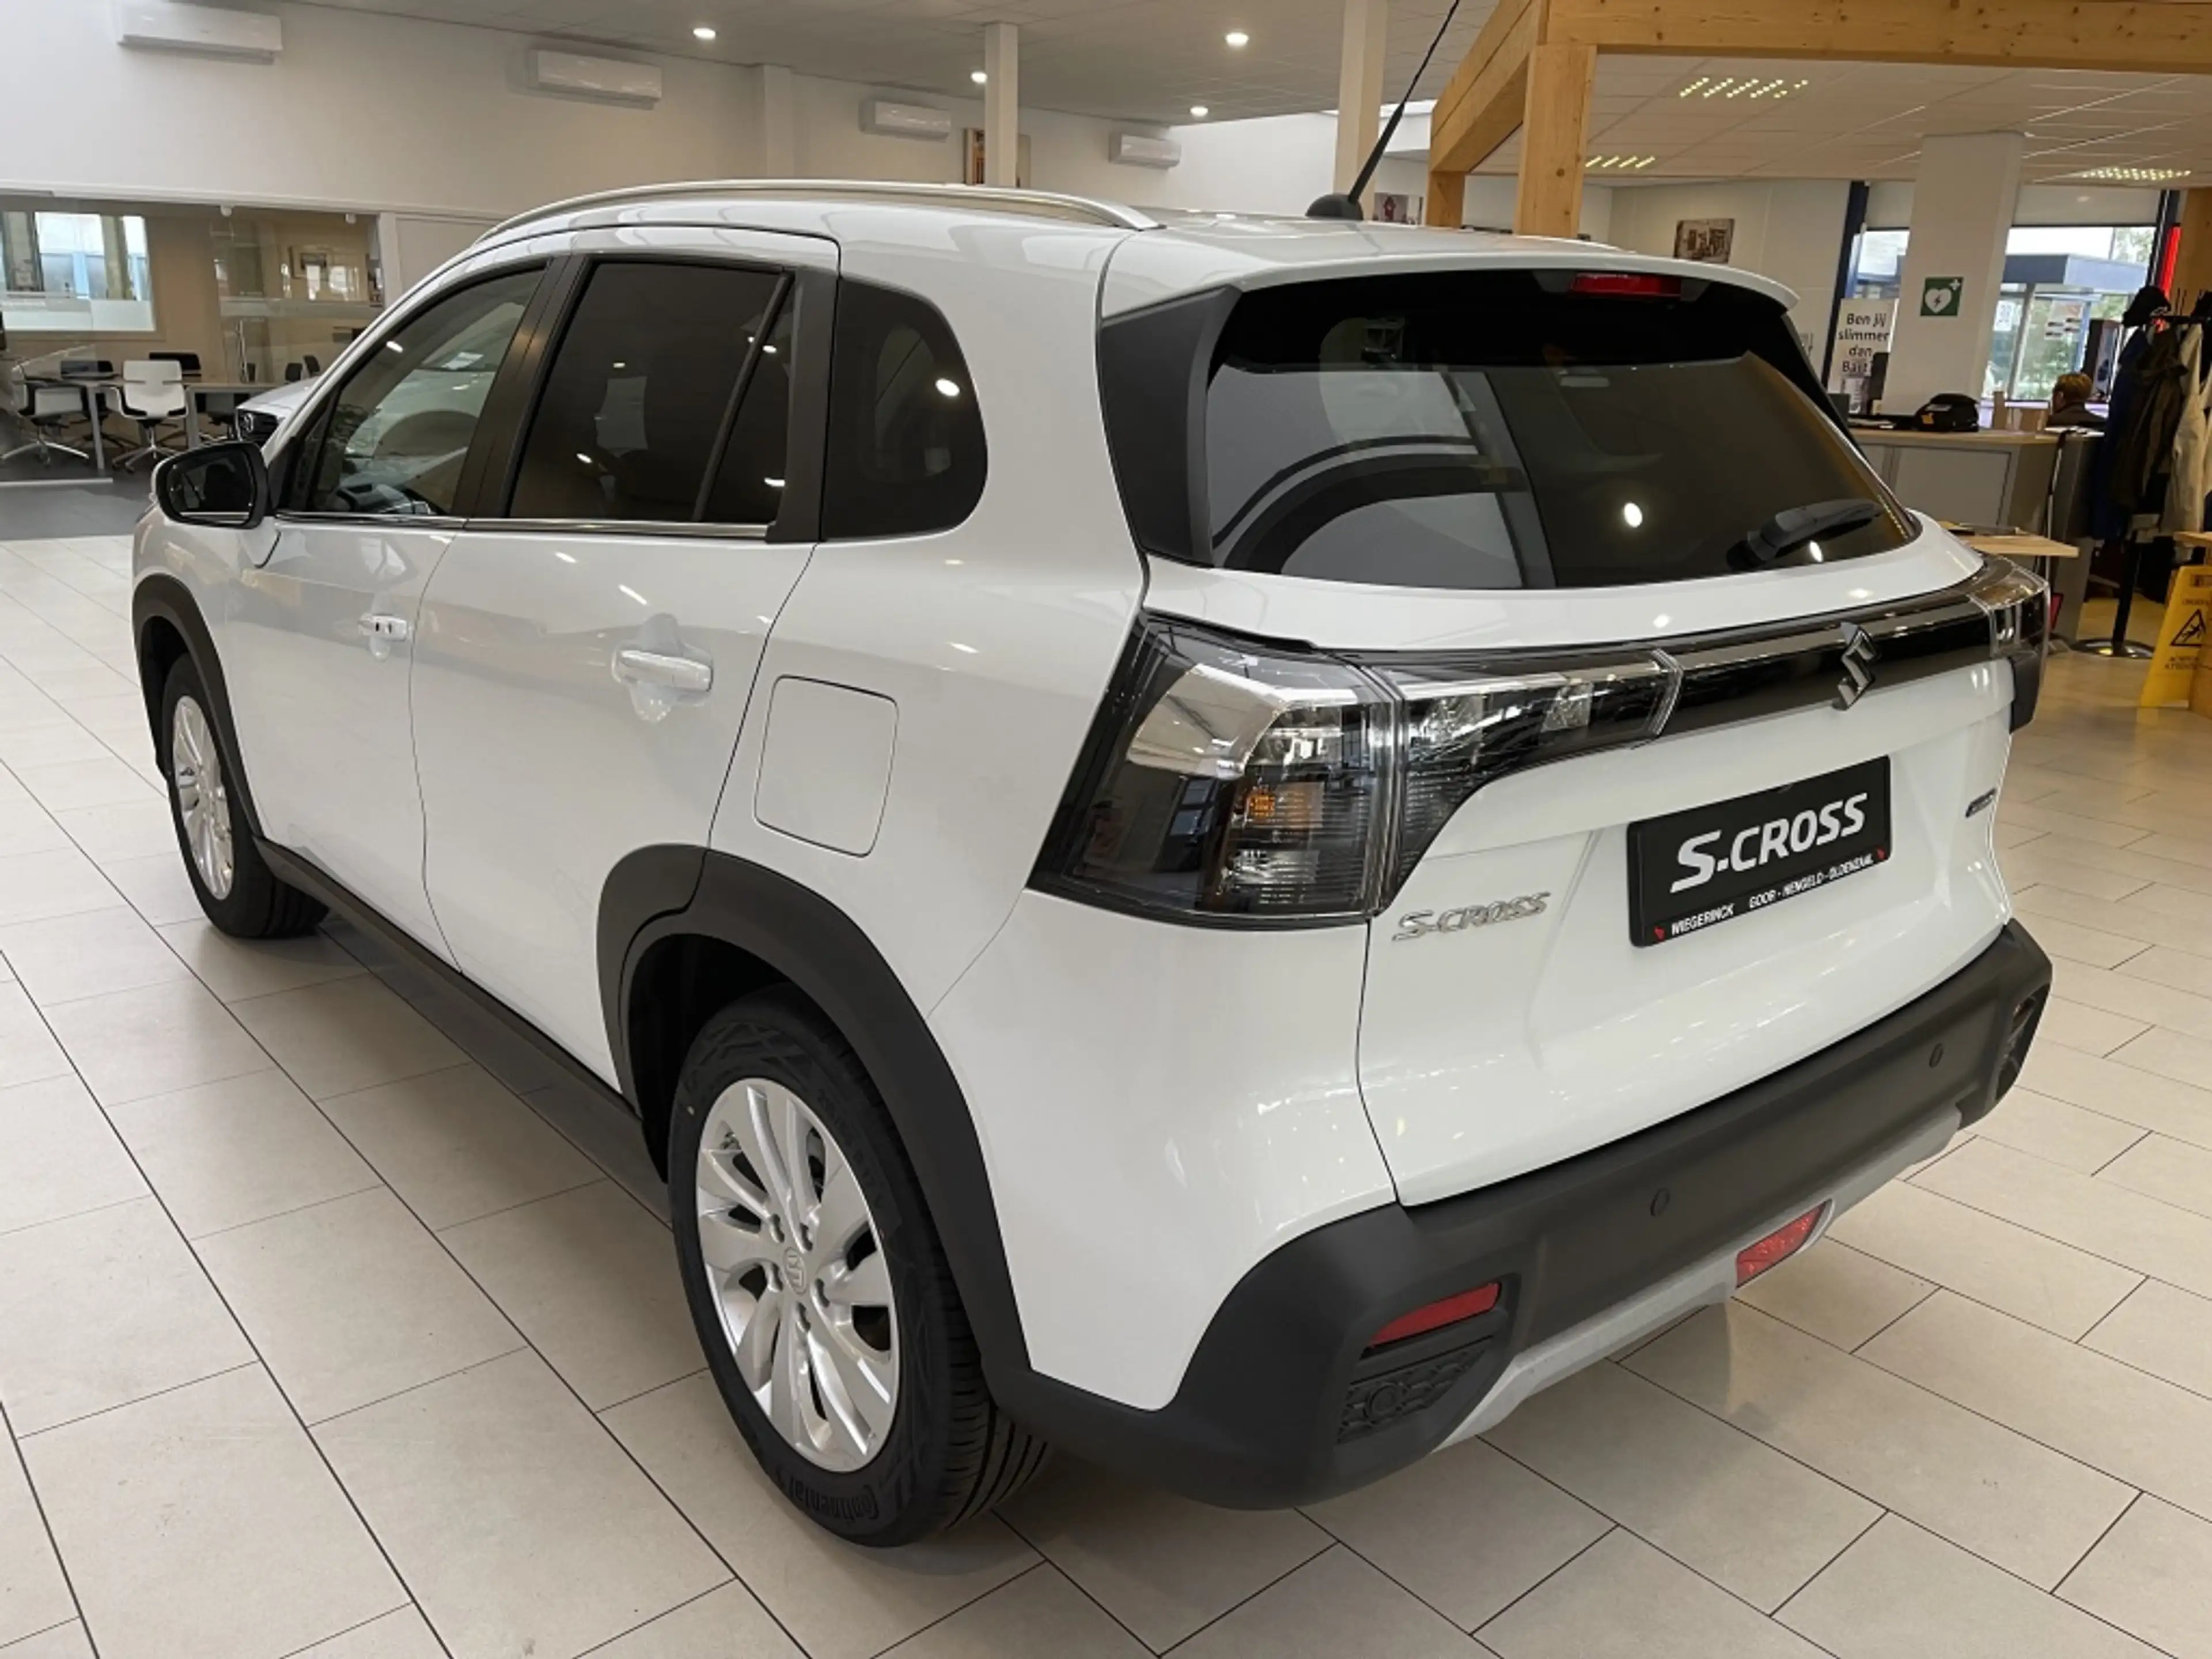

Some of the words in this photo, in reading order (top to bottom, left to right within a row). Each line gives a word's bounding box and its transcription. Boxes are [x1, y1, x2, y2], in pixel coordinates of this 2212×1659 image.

[1847, 313, 1871, 324] Ben
[1838, 328, 1889, 341] slimmer
[1849, 344, 1872, 357] dan
[1670, 793, 1868, 893] S-CROSS
[1391, 891, 1551, 941] S-CROSS
